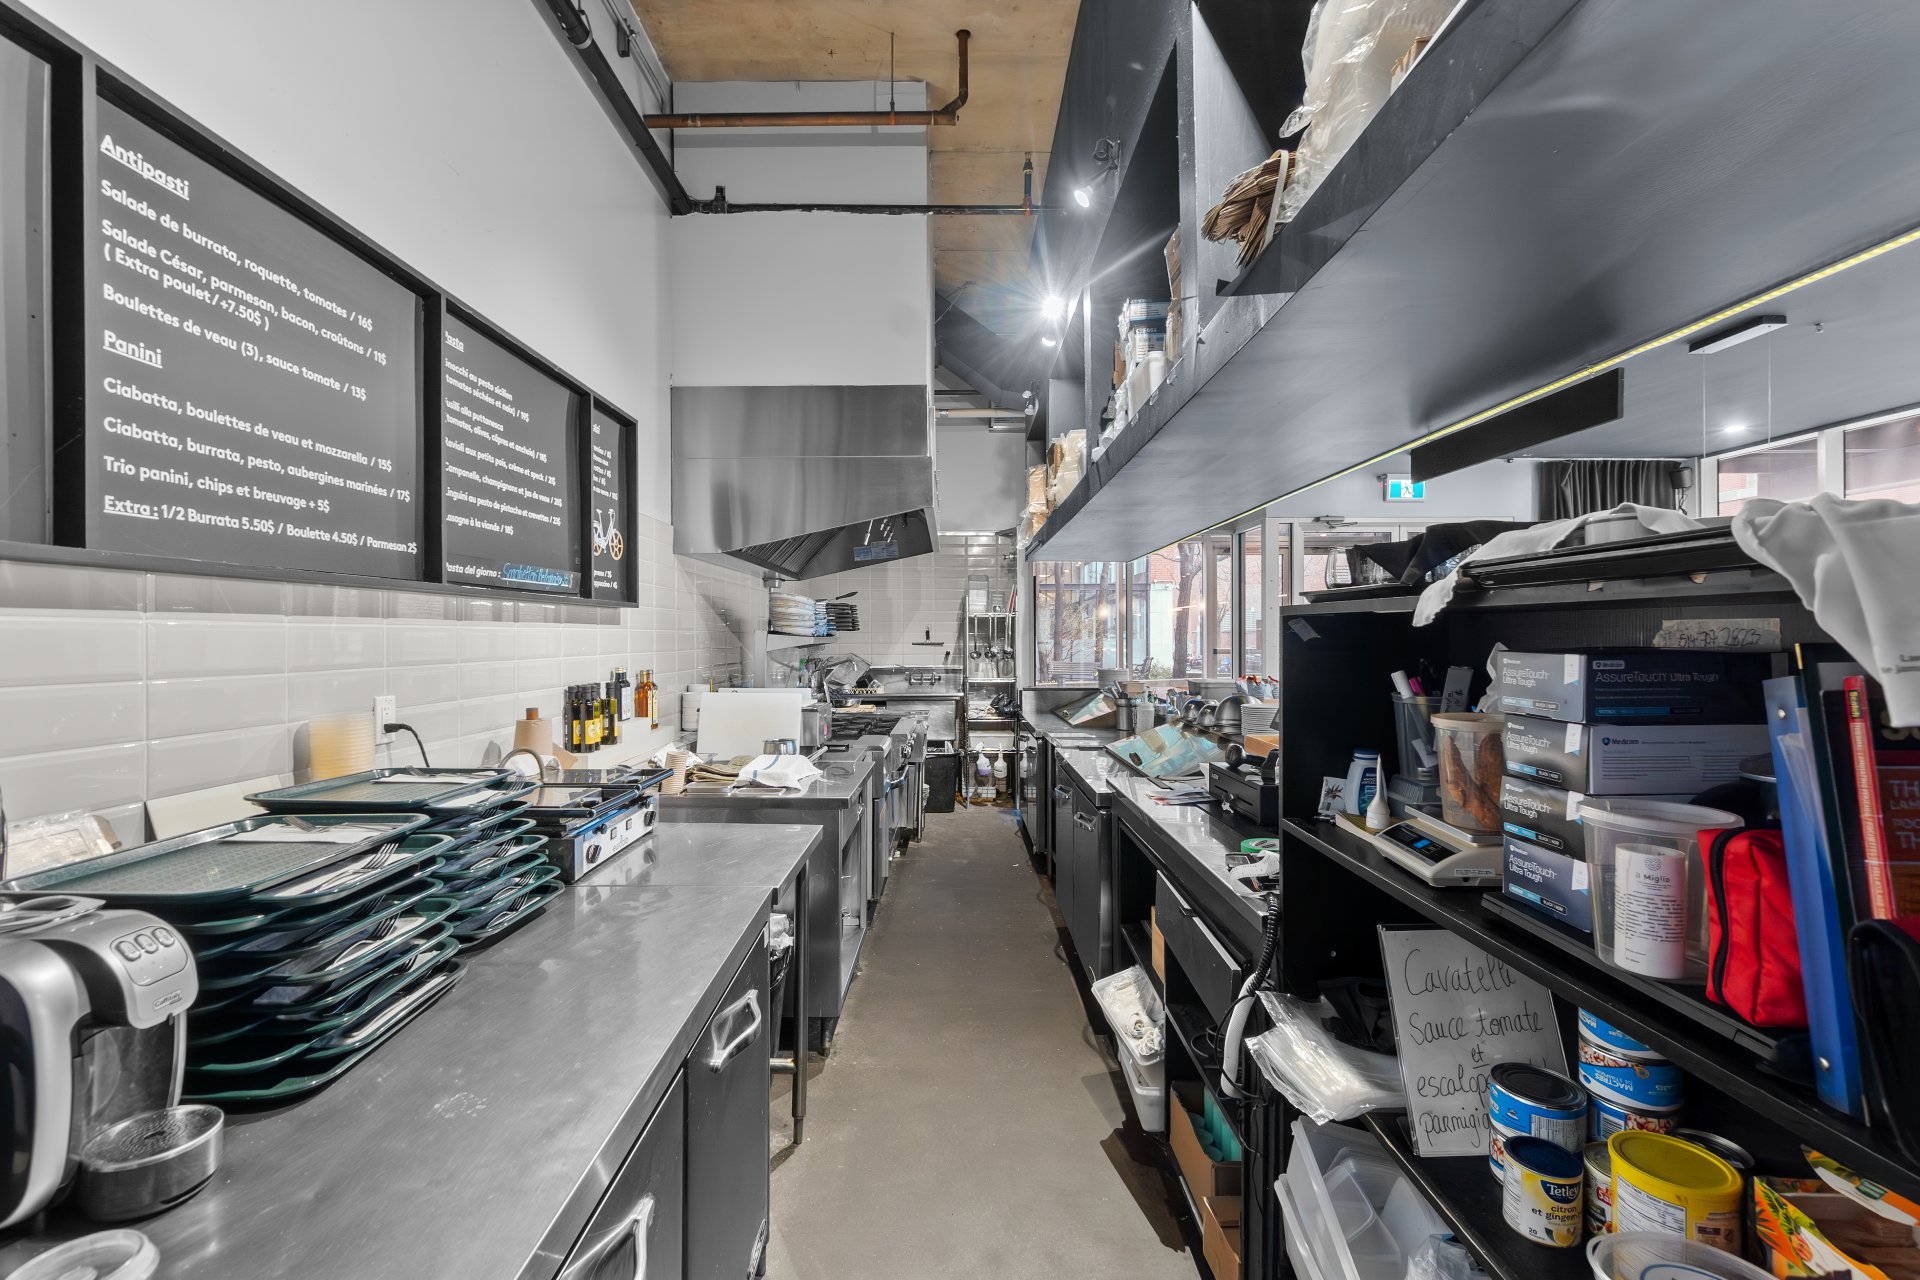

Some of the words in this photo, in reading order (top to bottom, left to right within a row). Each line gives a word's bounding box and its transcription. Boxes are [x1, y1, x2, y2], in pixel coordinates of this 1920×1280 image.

[100, 135, 190, 200] Antipasti
[101, 179, 157, 221] Salade
[160, 213, 179, 232] de
[182, 222, 241, 266] burrata,
[244, 258, 301, 296] roquette,
[303, 287, 347, 318] tomates
[357, 314, 373, 332] 16$
[101, 219, 157, 258] Salade
[160, 249, 207, 284] César,
[210, 275, 279, 317] parmesan,
[281, 306, 319, 336] bacon,
[320, 328, 364, 355] croûtons
[373, 350, 387, 366] 11$
[115, 246, 160, 281] Extra
[163, 273, 211, 304] poulet
[219, 299, 262, 327] +7.50$
[103, 283, 180, 328] Boulettes
[182, 318, 202, 336] de
[203, 328, 237, 351] veau
[241, 341, 264, 363] (3),
[266, 354, 300, 375] sauce
[301, 365, 341, 391] tomate
[350, 384, 367, 402] 13$
[103, 329, 163, 368] Panini
[445, 357, 468, 378] nocchi
[468, 373, 478, 383] au
[477, 377, 495, 391] pesto
[445, 397, 460, 412] usilli
[472, 411, 504, 432] puttanesca
[495, 400, 502, 409] et
[103, 376, 183, 415] Ciabatta,
[186, 401, 251, 432] boulettes
[254, 422, 269, 437] de
[271, 429, 299, 446] veau
[301, 438, 314, 450] et
[315, 442, 368, 465] mozzarella
[377, 457, 393, 473] 15$
[445, 412, 473, 433] tomates,
[473, 425, 491, 441] olives,
[508, 441, 515, 450] et
[103, 416, 183, 451] Ciabatta,
[186, 437, 244, 466] burrata,
[247, 455, 285, 474] pesto,
[287, 465, 345, 487] aubergines
[346, 479, 388, 496] marinées
[396, 489, 411, 503] 17$
[465, 446, 477, 457] aux
[477, 451, 494, 464] petits
[524, 468, 531, 477] et
[103, 455, 136, 476] Trio
[139, 466, 194, 489] panini,
[196, 476, 234, 496] chips
[236, 485, 250, 498] et
[253, 486, 307, 510] breuvage
[317, 499, 330, 514] 5$
[482, 474, 518, 494] champignons
[518, 487, 525, 496] et
[532, 490, 539, 500] de
[468, 495, 477, 503] au
[477, 498, 493, 508] pesto
[493, 500, 501, 510] de
[161, 504, 185, 521] 1/2
[187, 508, 240, 529] Burrata
[241, 516, 275, 535] 5.50$
[286, 523, 331, 542] Boulette
[331, 531, 358, 547] 4.50$
[366, 536, 407, 552] Parmesan
[407, 541, 418, 555] 2$
[474, 517, 482, 528] la
[481, 519, 501, 533] viande
[464, 564, 476, 575] del
[475, 566, 497, 578] giorno
[1517, 678, 1536, 688] Tough
[1520, 743, 1538, 755] Tough
[1519, 806, 1538, 819] Tough
[1524, 868, 1543, 883] Tough
[1643, 874, 1671, 883] Miglio
[1409, 1012, 1469, 1046] Sauce
[1474, 1000, 1544, 1038] tomate
[1470, 1043, 1486, 1064] et
[1419, 1106, 1490, 1148] parmigia
[1547, 1183, 1579, 1200] Tetley
[1531, 1207, 1543, 1217] et
[1545, 1212, 1580, 1223] gingem
[1551, 1205, 1577, 1213] citron
[1528, 1227, 1538, 1235] 20
